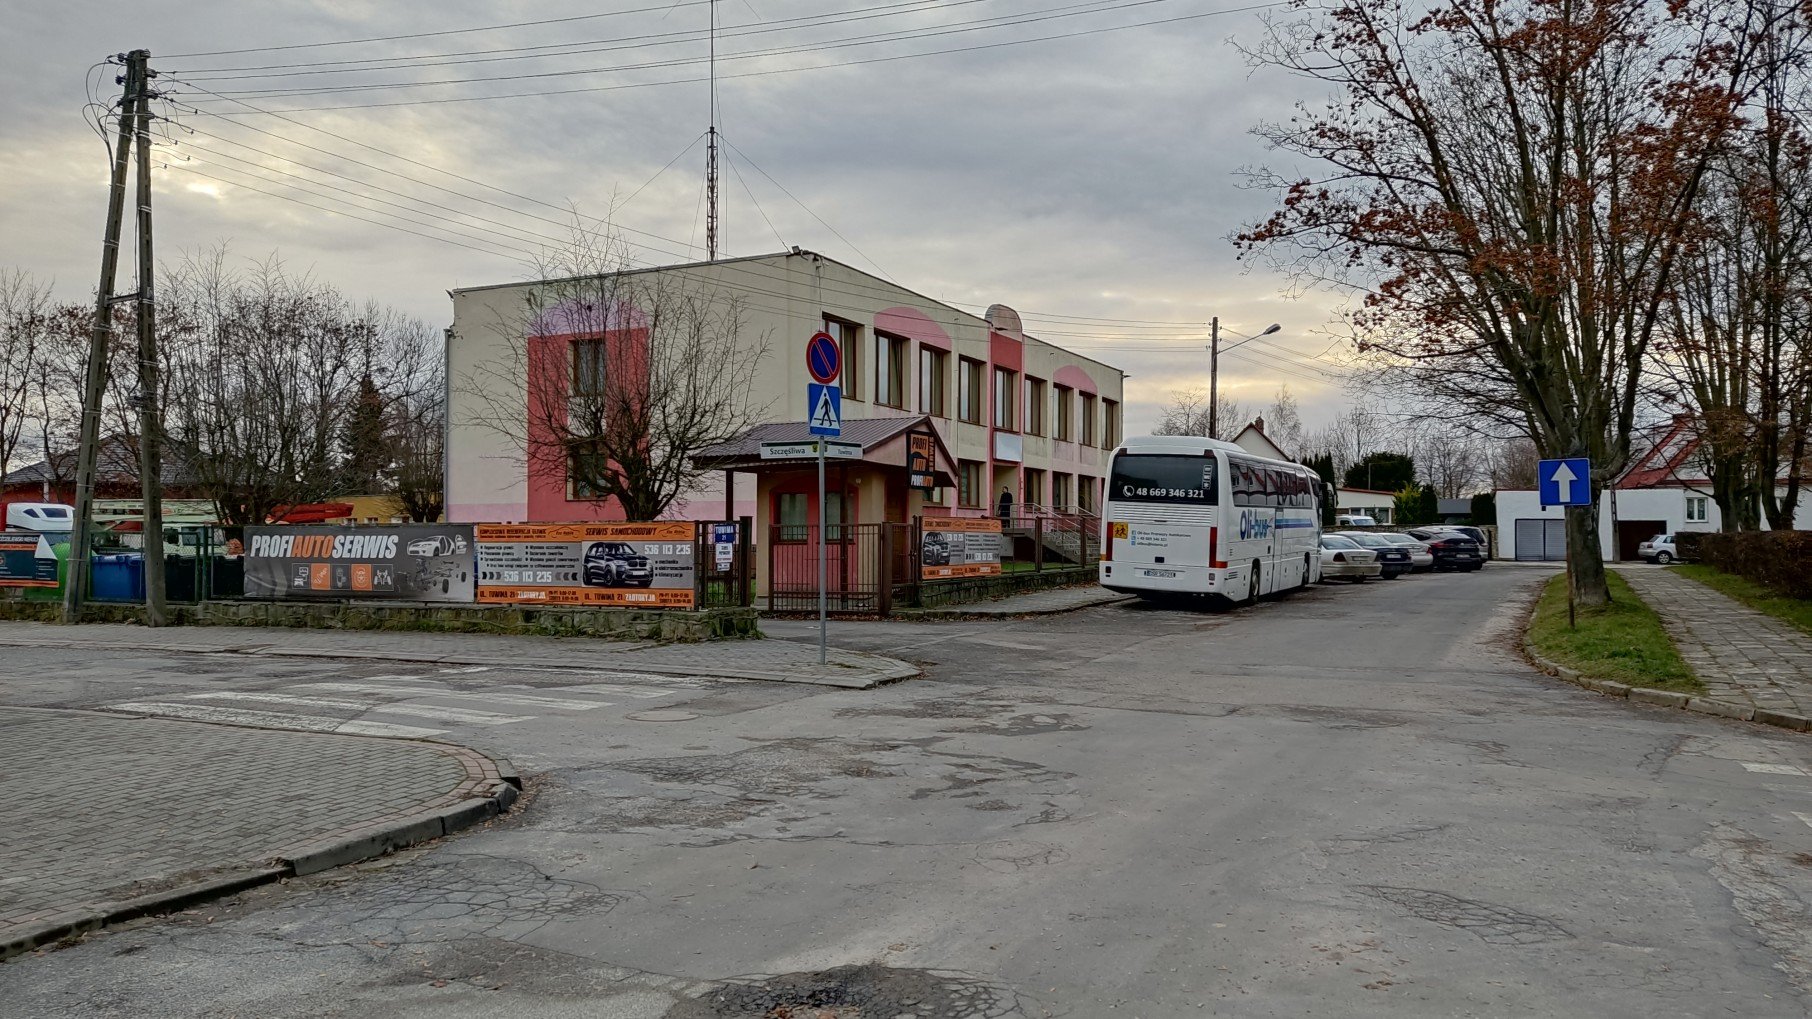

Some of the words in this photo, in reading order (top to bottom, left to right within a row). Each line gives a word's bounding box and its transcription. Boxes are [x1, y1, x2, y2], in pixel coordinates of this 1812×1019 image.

[769, 447, 806, 456] Szczęśliwa
[1136, 487, 1148, 496] 48
[1149, 488, 1167, 497] 669
[1168, 488, 1186, 497] 346
[1187, 489, 1205, 498] 321
[585, 527, 609, 536] SERWIS
[610, 527, 658, 536] SAMOCHODOWY
[250, 535, 399, 559] PROFIAUTOSERWIS
[644, 544, 659, 555] 536
[662, 544, 673, 555] 113
[675, 544, 691, 555] 235
[504, 570, 519, 582] 536
[522, 571, 533, 582] 113
[536, 571, 552, 583] 235
